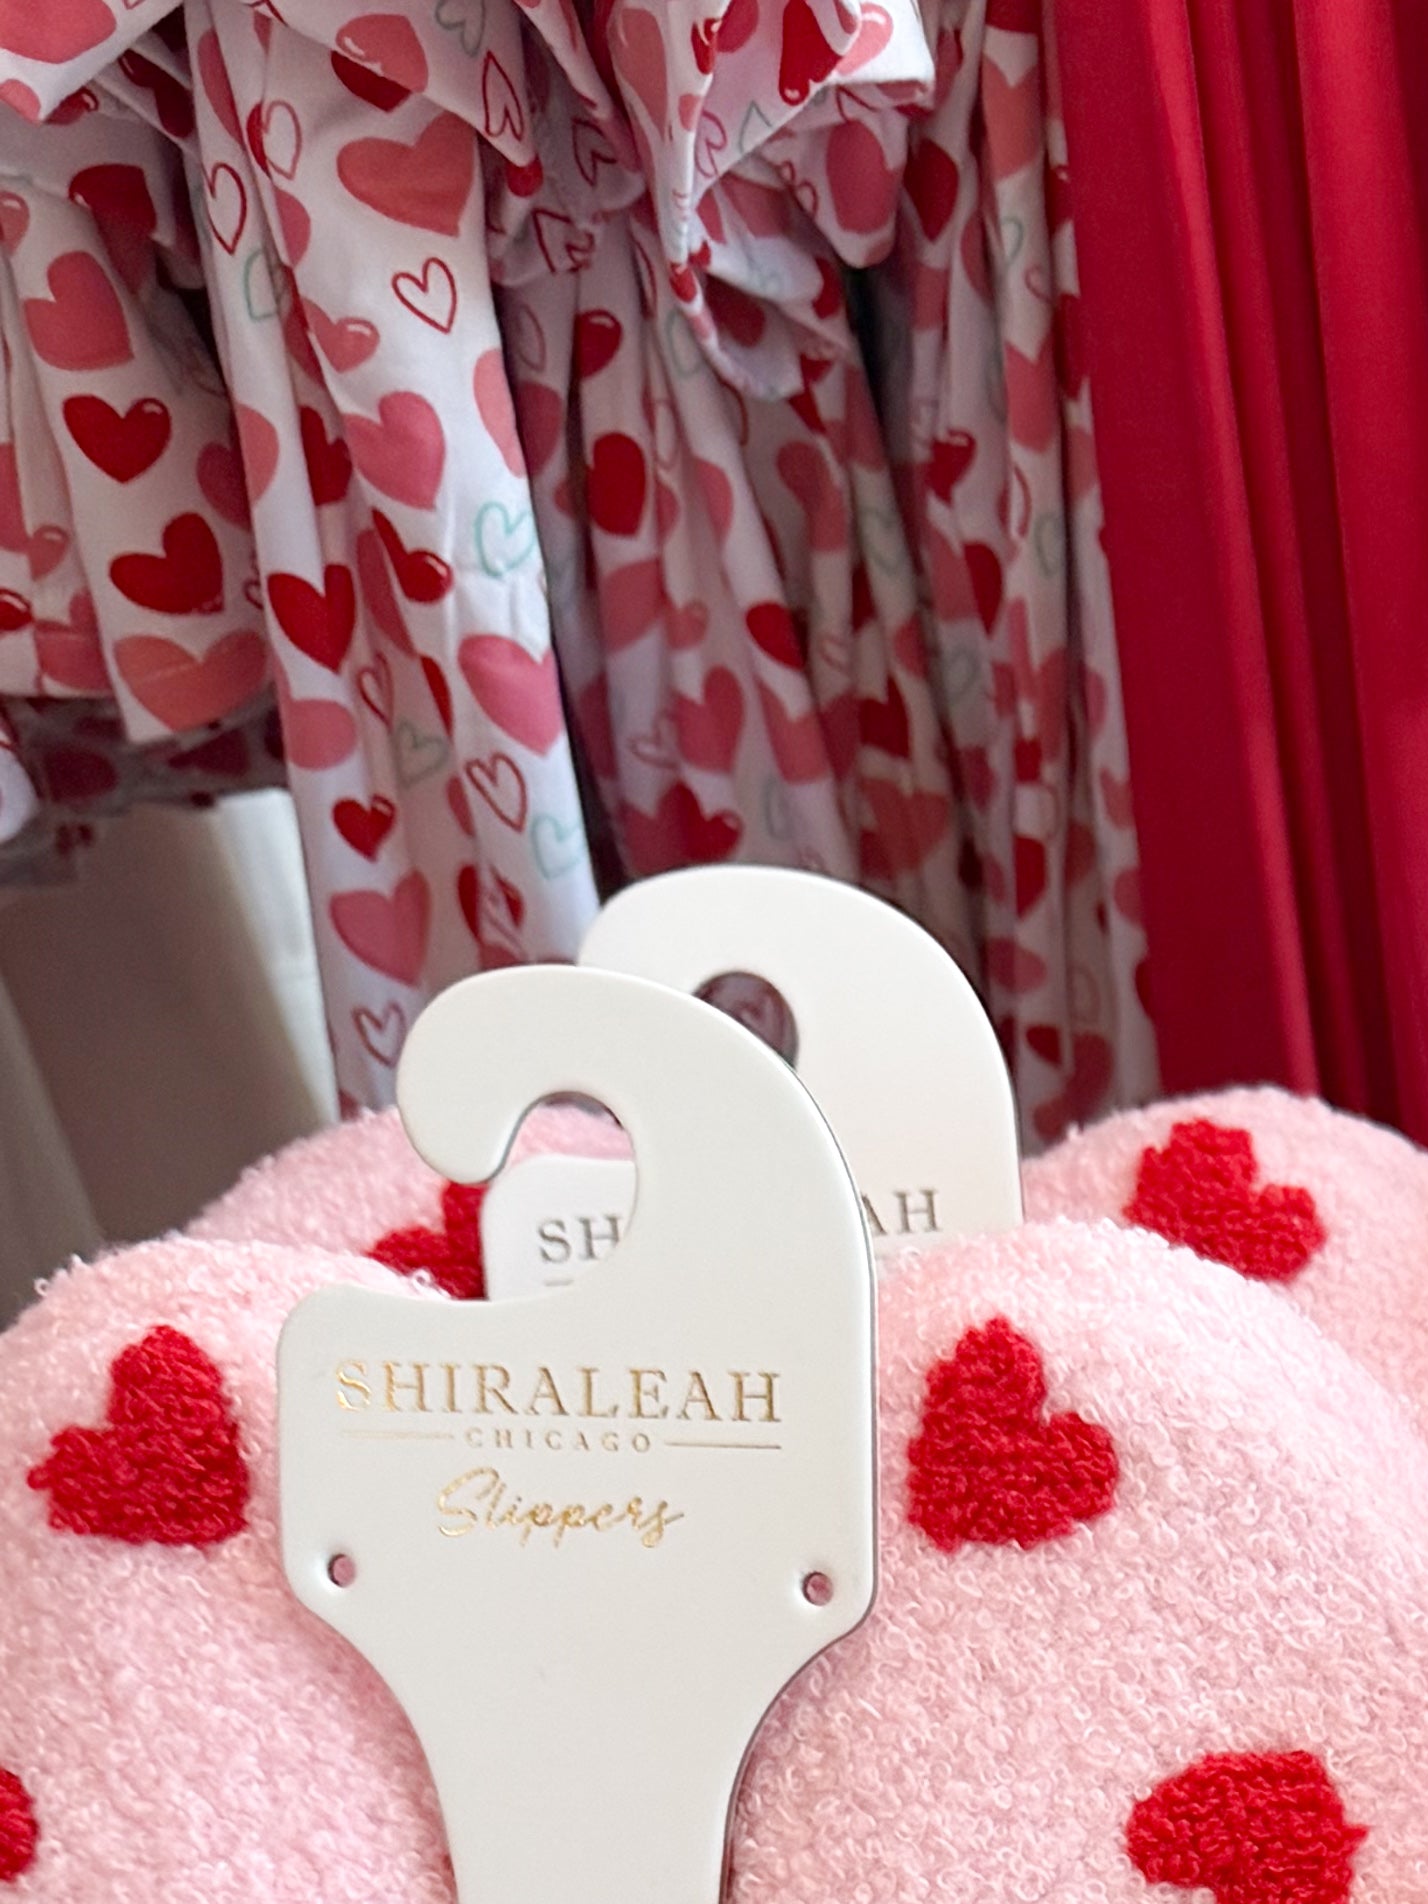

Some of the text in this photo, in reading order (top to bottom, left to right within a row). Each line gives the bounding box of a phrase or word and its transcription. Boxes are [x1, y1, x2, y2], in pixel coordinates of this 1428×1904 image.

[333, 1358, 783, 1425] SHIRALEAH
[465, 1426, 653, 1454] CHICAGO
[435, 1466, 685, 1548] Slippers
